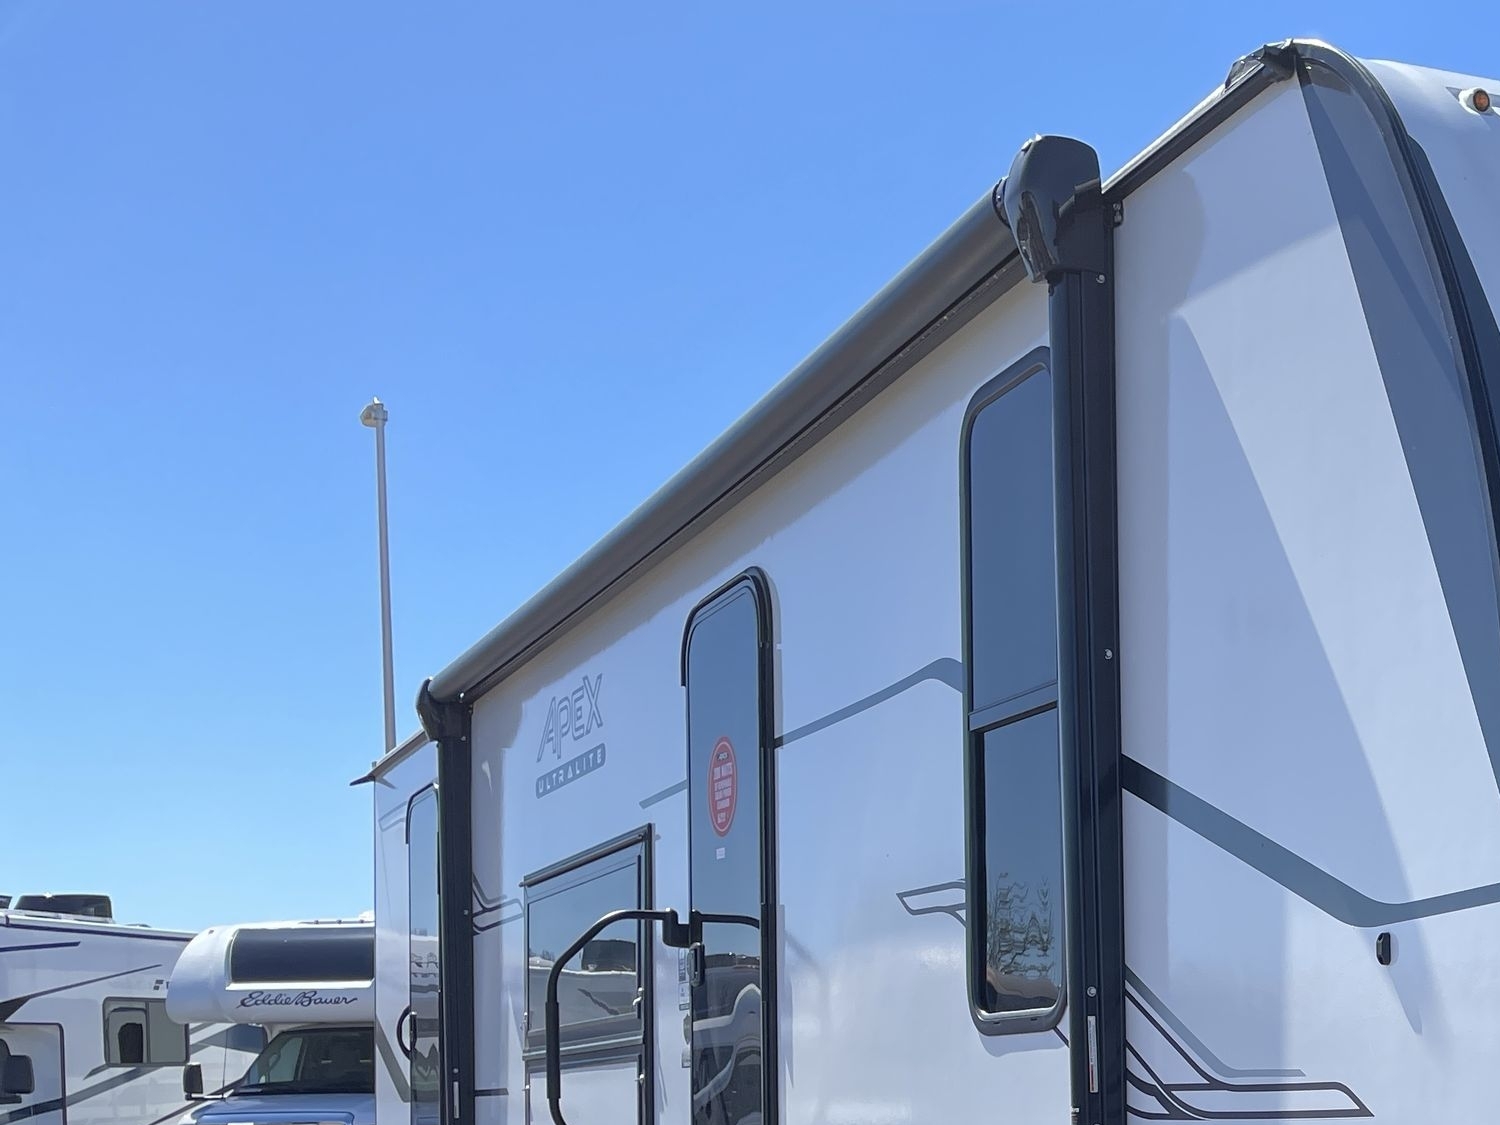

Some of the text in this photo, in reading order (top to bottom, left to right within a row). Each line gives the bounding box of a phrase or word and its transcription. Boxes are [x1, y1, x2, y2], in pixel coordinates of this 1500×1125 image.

[536, 672, 603, 763] APEX
[538, 747, 602, 794] ULTRALITE
[236, 990, 358, 1008] Eddie Bauer
